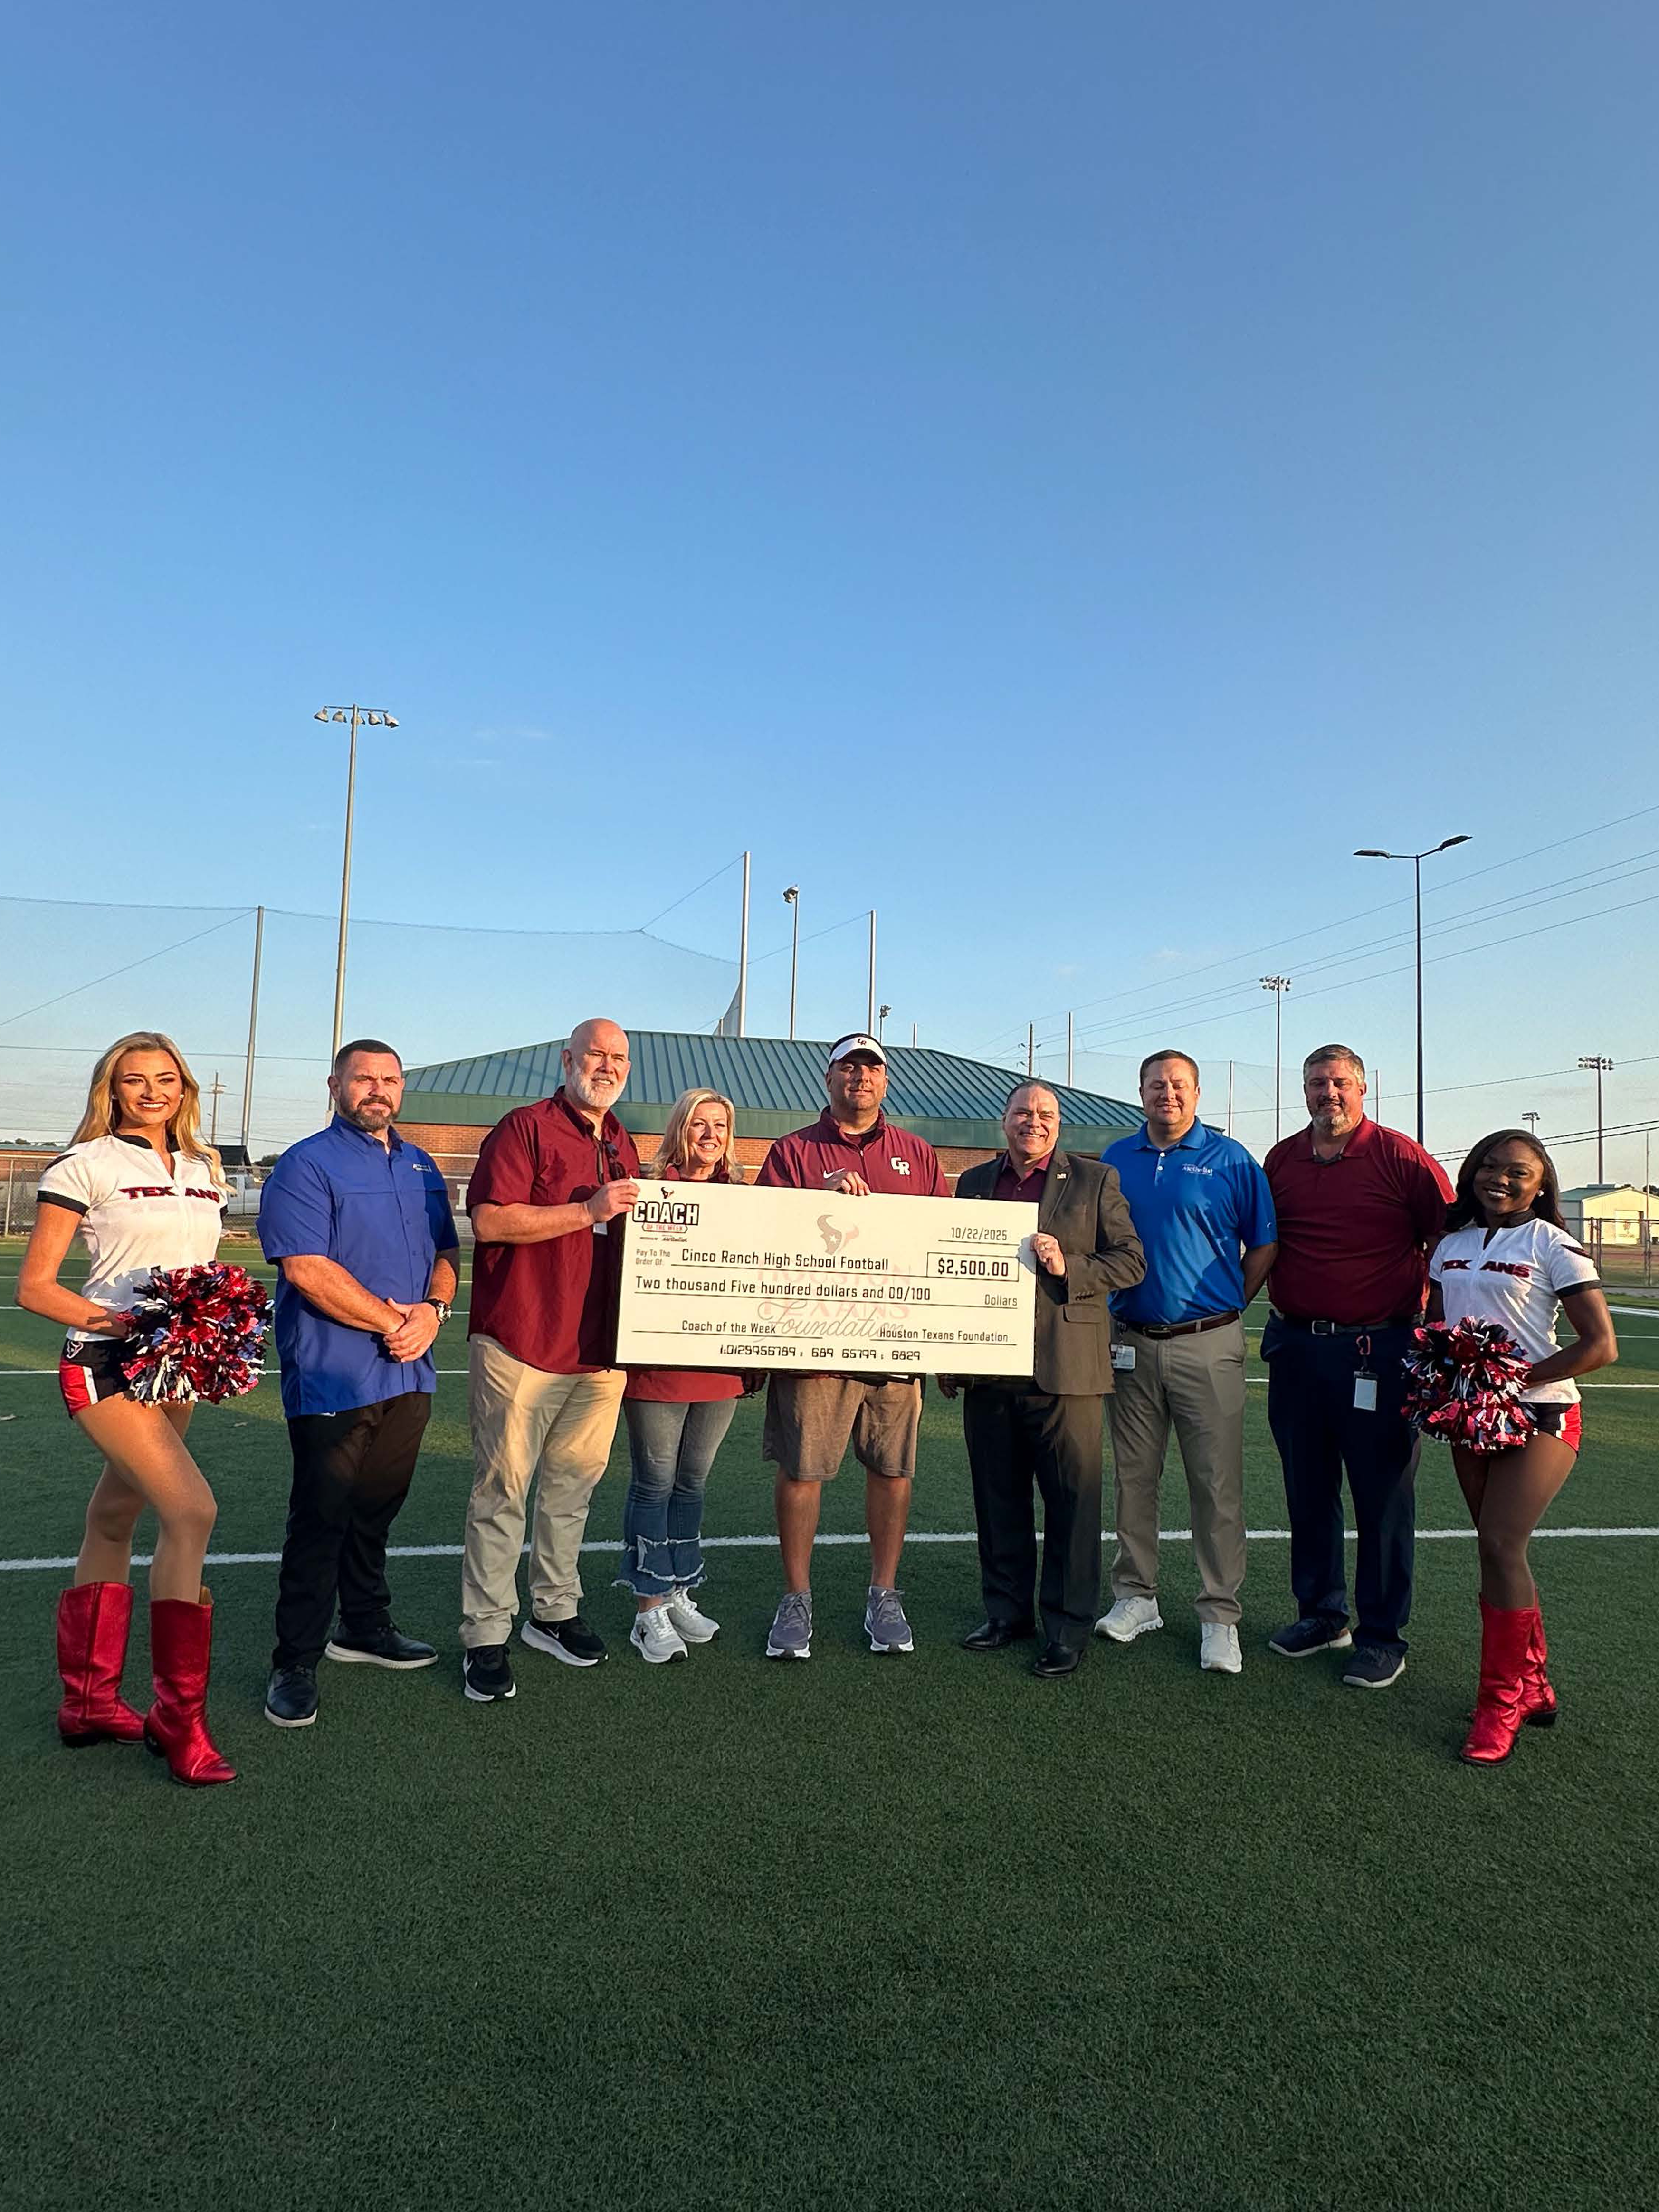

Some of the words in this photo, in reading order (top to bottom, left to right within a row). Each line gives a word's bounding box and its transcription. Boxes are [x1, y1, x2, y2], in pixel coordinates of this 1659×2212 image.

[890, 1156, 911, 1175] CR
[632, 1201, 700, 1225] COACH
[951, 1227, 1008, 1240] 10/22/2025
[636, 1249, 648, 1257] Pay
[682, 1248, 716, 1262] Cinco
[721, 1250, 759, 1265] Ranch
[764, 1252, 790, 1268] High
[796, 1254, 836, 1268] School
[841, 1256, 888, 1270] Football
[938, 1257, 1008, 1277] $2,500.00
[636, 1276, 660, 1289] Two
[666, 1277, 726, 1292] thousand
[731, 1280, 756, 1293] Five
[761, 1281, 811, 1296] hundred
[816, 1284, 858, 1297] dollars
[862, 1286, 884, 1298] and
[889, 1286, 930, 1302] 00/100
[984, 1294, 1018, 1306] Dollars
[682, 1320, 713, 1331] Coach
[716, 1322, 727, 1332] of
[731, 1323, 746, 1333] the
[751, 1322, 776, 1334] Week
[879, 1327, 918, 1339] Houston
[922, 1329, 954, 1340] Texans
[958, 1330, 1008, 1342] Foundation
